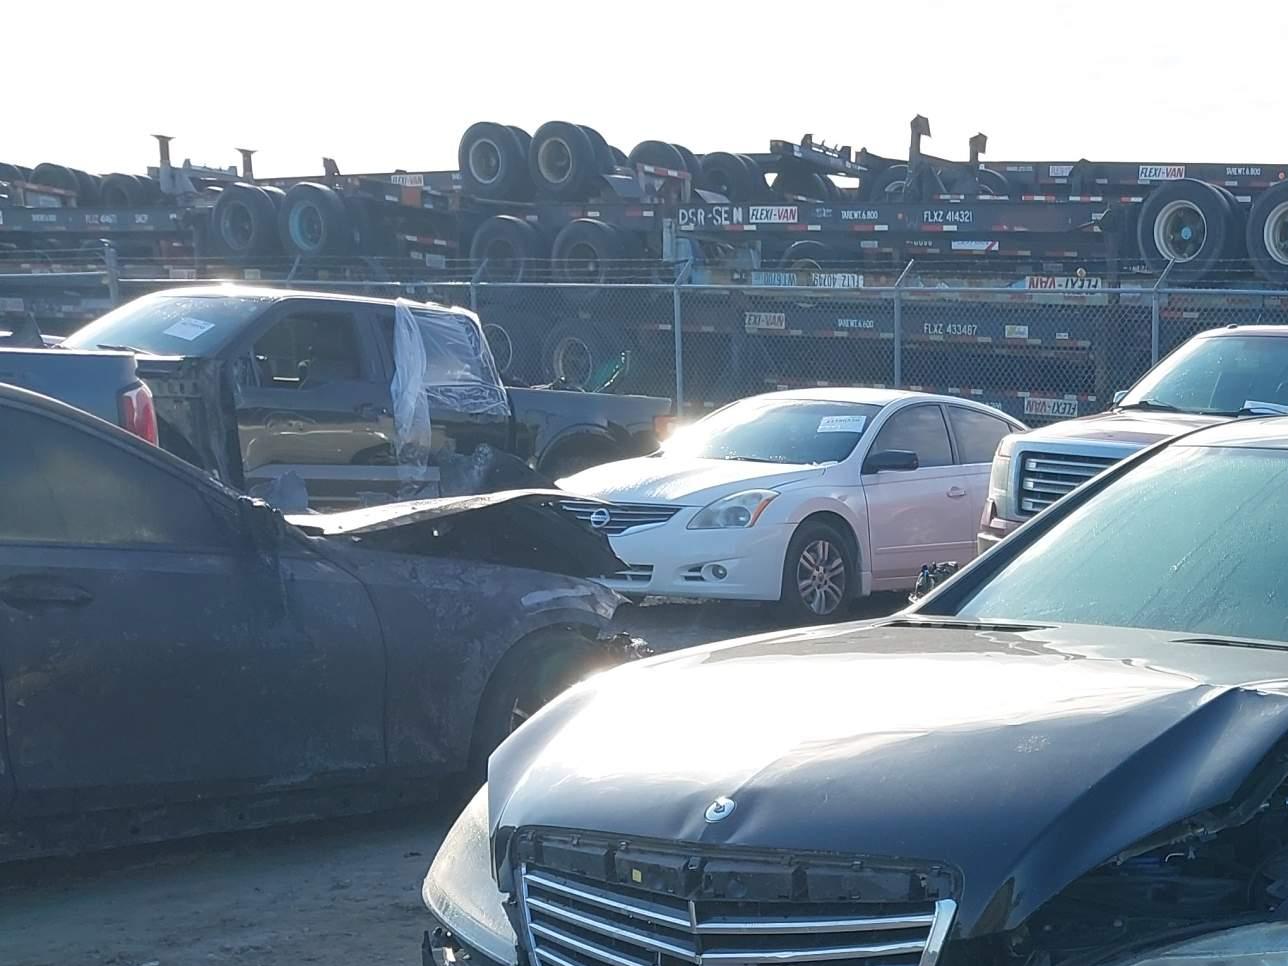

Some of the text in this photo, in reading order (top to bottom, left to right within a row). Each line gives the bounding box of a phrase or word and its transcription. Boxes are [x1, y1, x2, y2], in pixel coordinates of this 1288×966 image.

[1139, 166, 1184, 179] FLEXI-VAN
[750, 207, 798, 223] FLEXI-VAN
[924, 211, 973, 223] FLXZ 414321
[923, 323, 943, 335] FLXZ
[1025, 400, 1077, 415] FLEXI-VAN
